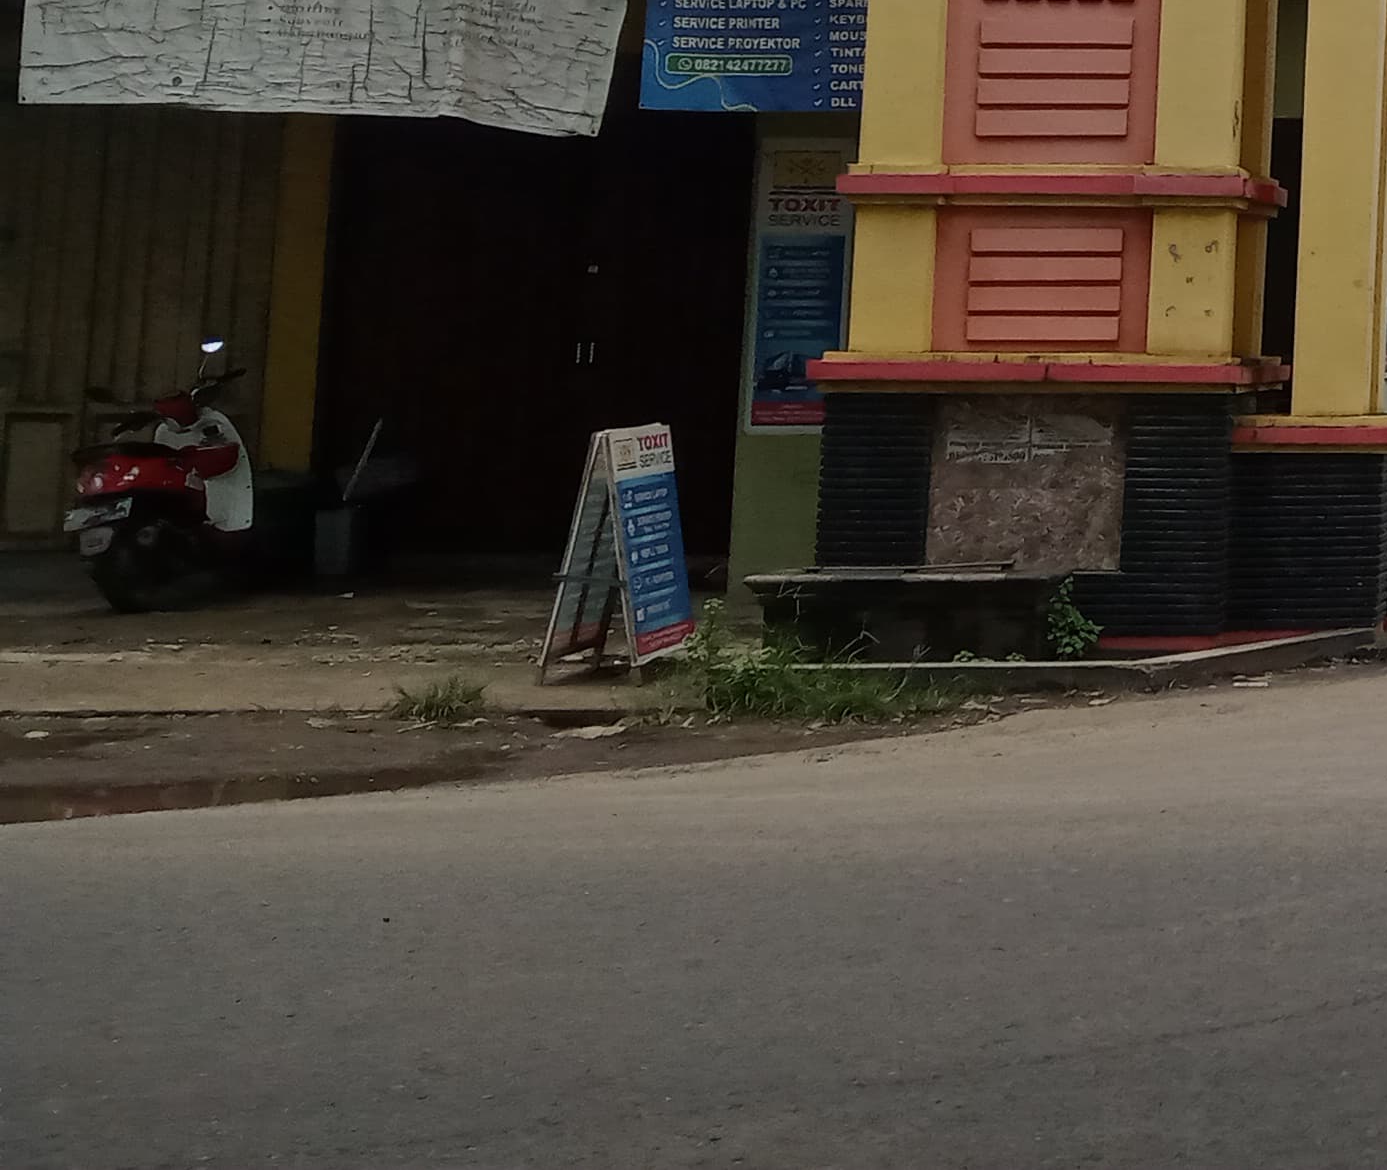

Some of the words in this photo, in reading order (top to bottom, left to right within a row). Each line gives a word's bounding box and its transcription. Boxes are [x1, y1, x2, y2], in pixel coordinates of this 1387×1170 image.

[674, 17, 725, 29] SERVICE
[729, 17, 780, 29] PRINTER
[672, 36, 725, 49] SERVICE
[728, 37, 801, 49] PROYEKTOR
[831, 97, 856, 107] DLL
[769, 198, 840, 212] TOXIT
[768, 214, 840, 226] SERVICE
[637, 433, 668, 451] TOXIT
